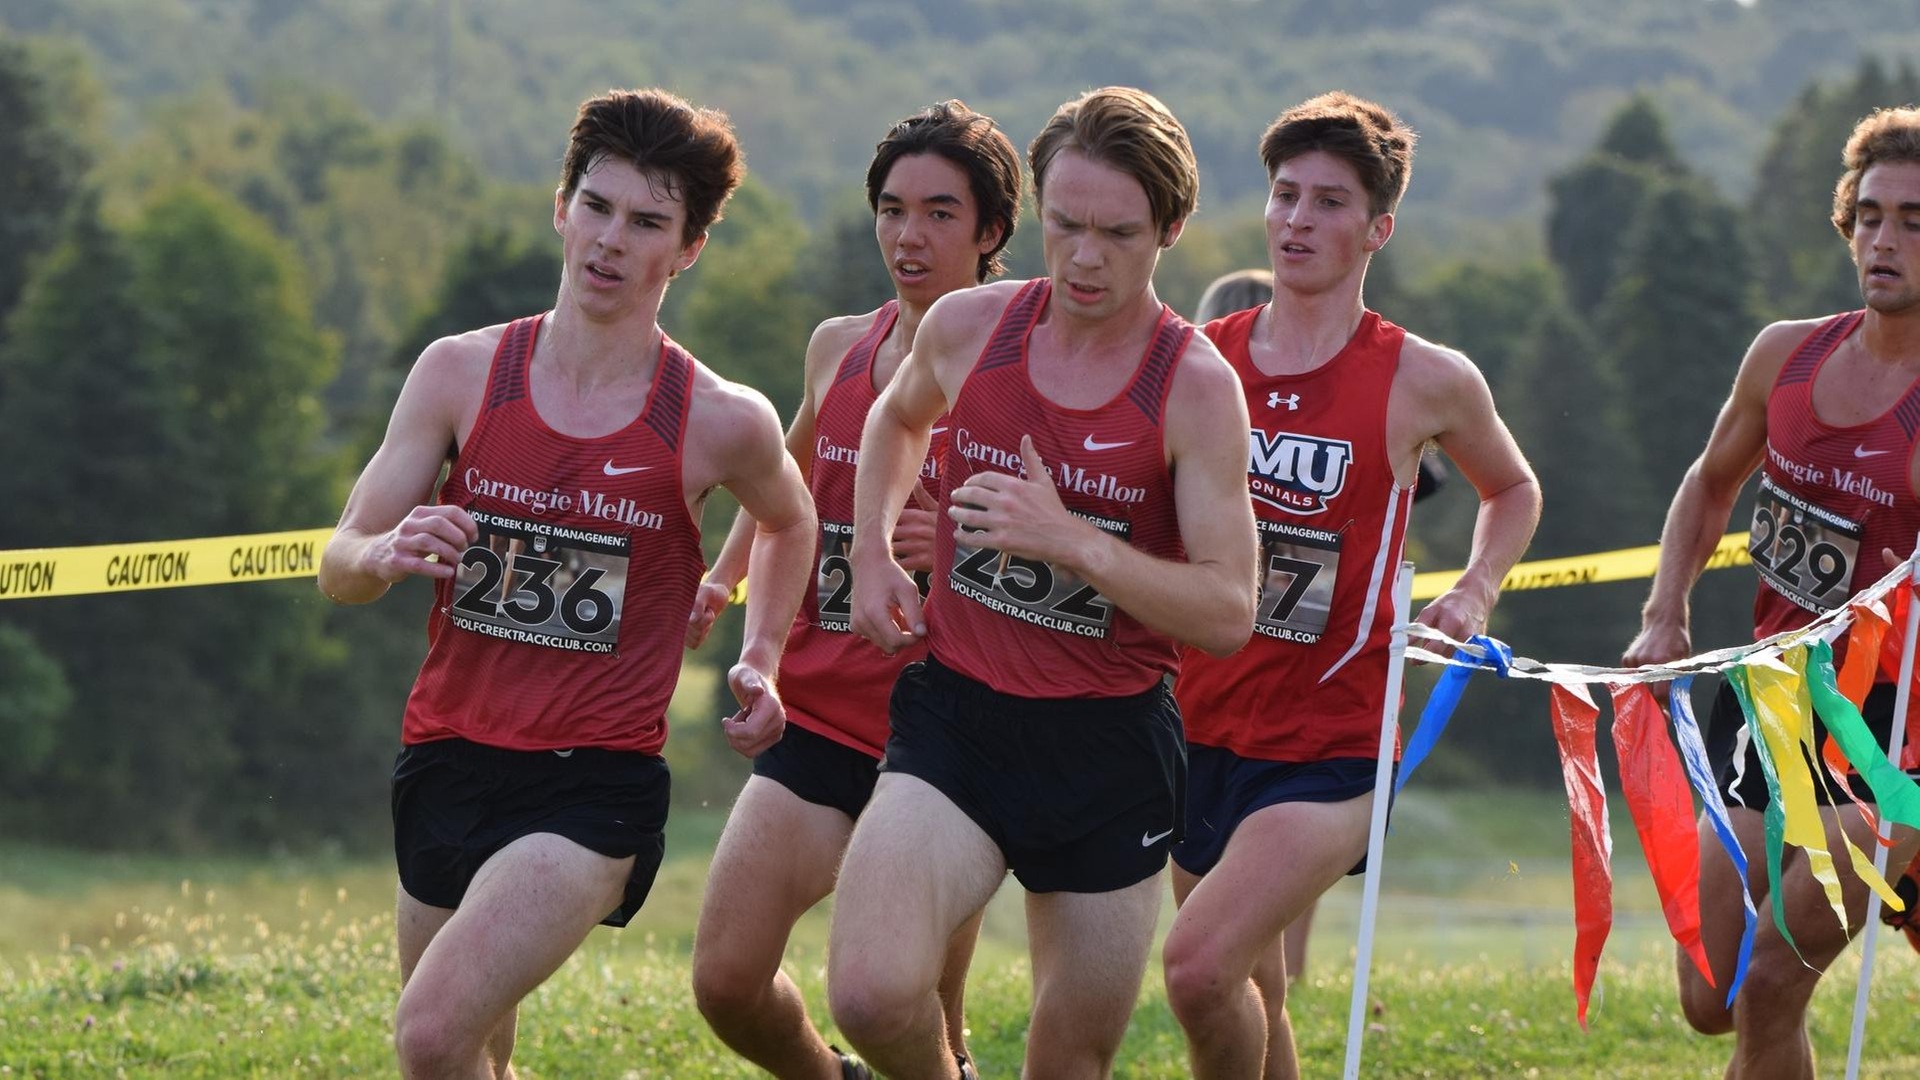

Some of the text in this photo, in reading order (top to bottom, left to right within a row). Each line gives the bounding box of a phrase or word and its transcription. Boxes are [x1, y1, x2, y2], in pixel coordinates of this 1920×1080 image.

[817, 436, 860, 465] Carn
[957, 428, 1052, 482] Carne
[1057, 463, 1146, 503] Mellon
[1248, 432, 1347, 495] MU
[1767, 442, 1895, 507] rnegie Mellon
[464, 467, 664, 530] Carnegie Mellon
[1248, 479, 1312, 506] ONIALS
[491, 516, 522, 533] CREEK
[524, 522, 551, 536] RACE
[1750, 507, 1847, 600] 229
[0, 542, 315, 594] UTION CAUTION CAUTION
[452, 546, 616, 636] 236
